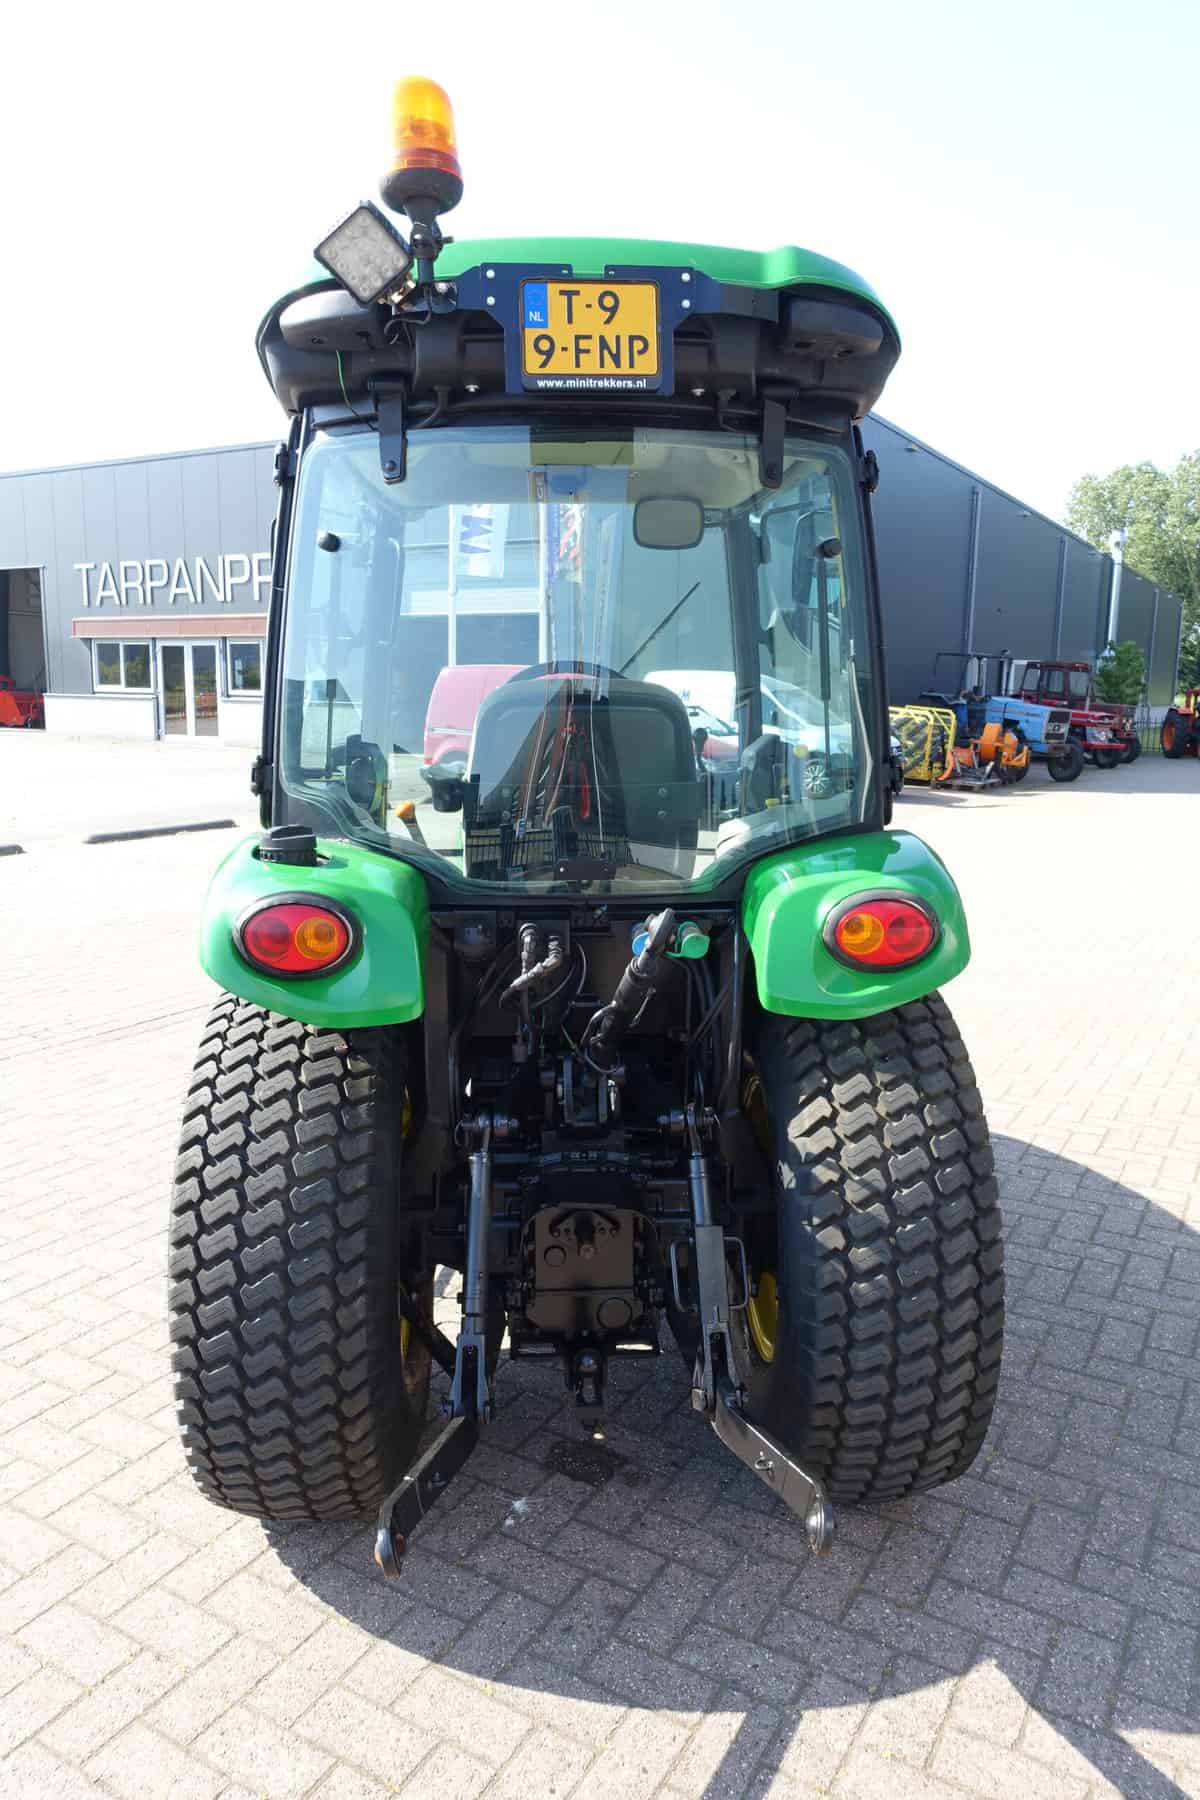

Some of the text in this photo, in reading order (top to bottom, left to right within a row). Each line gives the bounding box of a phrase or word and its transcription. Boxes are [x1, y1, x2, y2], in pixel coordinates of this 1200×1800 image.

[529, 311, 544, 322] NL
[558, 290, 620, 325] T-9
[533, 334, 649, 369] 9-FNP
[536, 378, 647, 388] www.minitrekkers.nl
